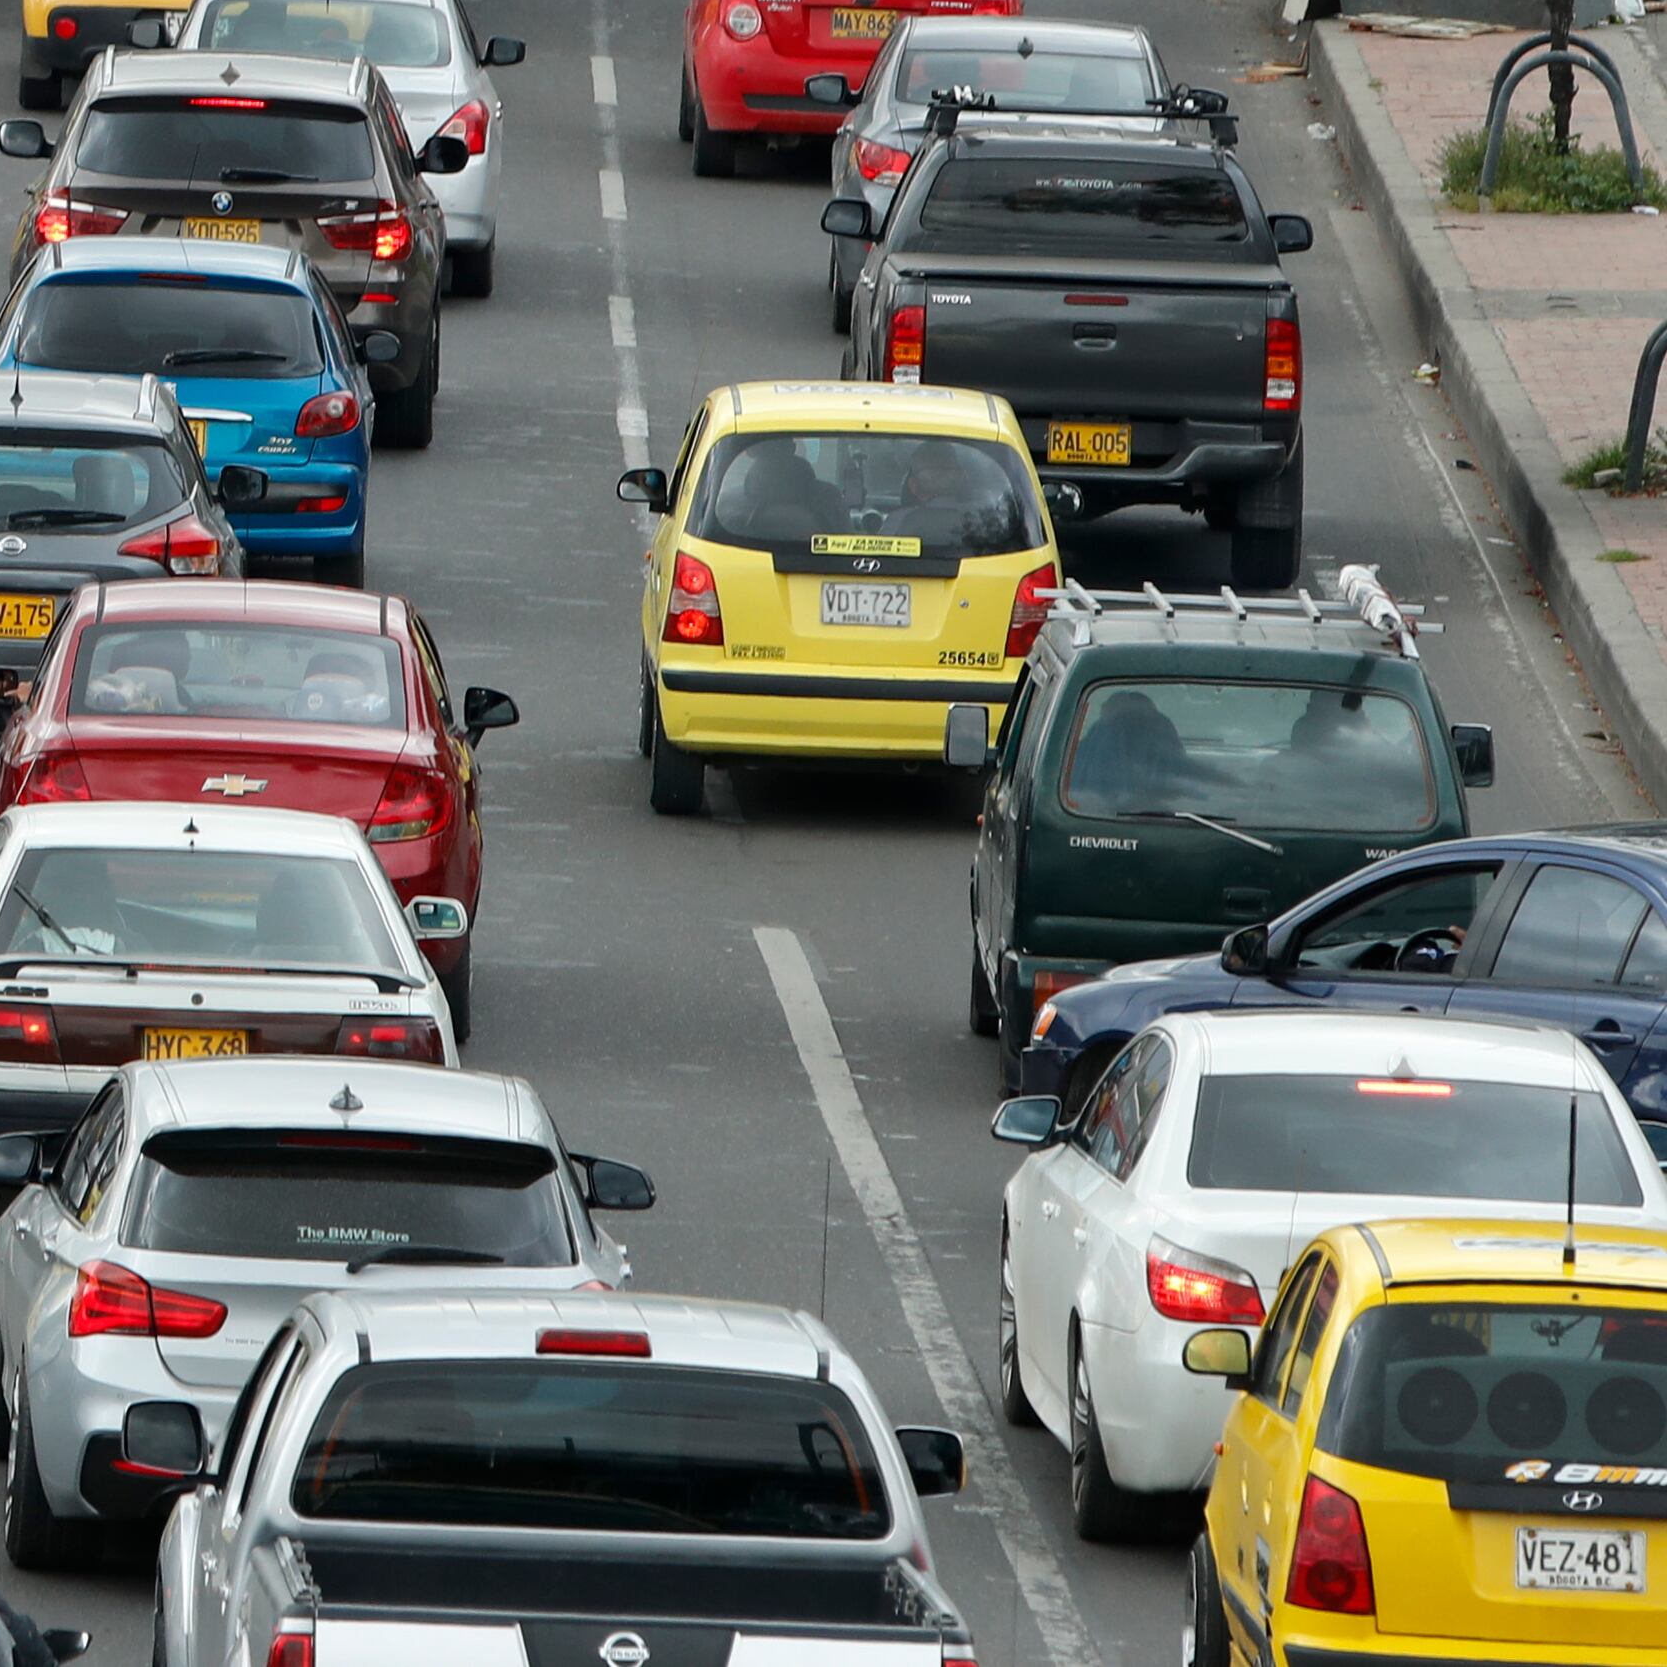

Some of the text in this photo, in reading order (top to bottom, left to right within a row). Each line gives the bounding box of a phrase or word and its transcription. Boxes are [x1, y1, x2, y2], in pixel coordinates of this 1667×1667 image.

[931, 294, 972, 304] TOYOTA
[1051, 430, 1127, 453] RAL·005
[826, 589, 908, 615] VDT·722
[938, 650, 987, 666] 25654
[1069, 836, 1139, 852] CHEVROLET
[297, 1226, 325, 1239] The
[328, 1227, 369, 1241] BMW
[371, 1229, 410, 1243] Store
[1521, 1539, 1638, 1575] VEZ·481
